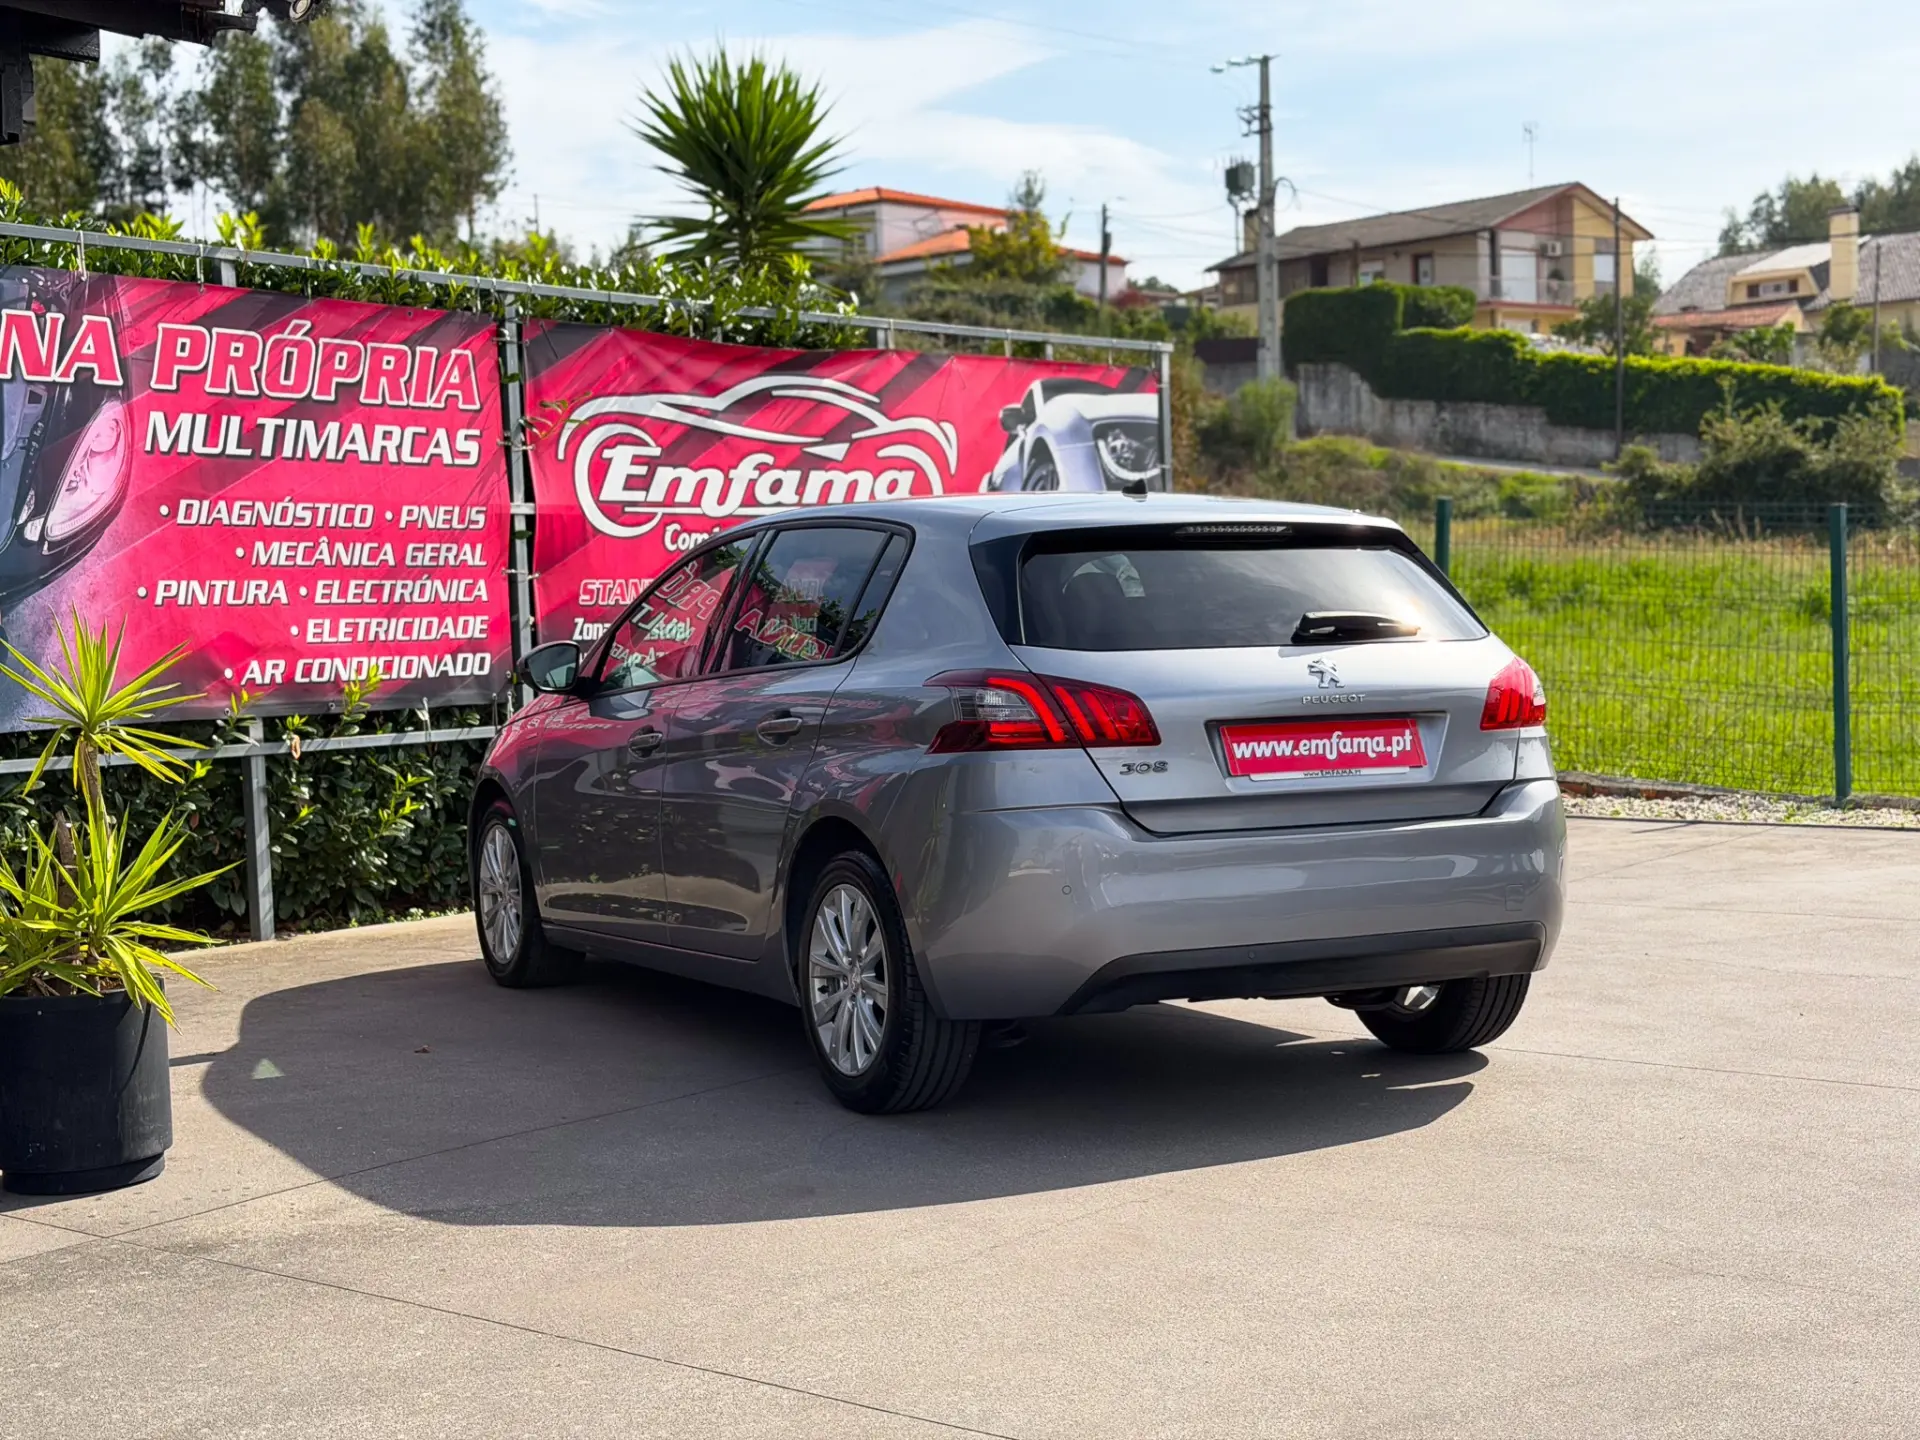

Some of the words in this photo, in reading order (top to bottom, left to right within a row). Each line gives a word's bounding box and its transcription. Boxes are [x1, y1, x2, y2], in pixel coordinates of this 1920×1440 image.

[150, 320, 481, 411] PRÓPRIA
[144, 411, 482, 466] MULTIMARCAS
[598, 446, 916, 518] Emfama
[176, 496, 374, 528] DIAGNÓSTICO
[399, 504, 487, 530] PNEUS
[251, 537, 396, 567] MECÂNICA
[404, 542, 488, 567] GERAL
[664, 523, 720, 551] Com
[154, 579, 289, 606] PINTURA
[314, 575, 488, 604] ELECTRÓNICA
[305, 615, 489, 644] ELETRICIDADE
[240, 659, 286, 686] AR
[1302, 694, 1366, 704] PEUGEOT
[1231, 729, 1413, 760] www.emfama.pt
[1119, 761, 1168, 775] 308
